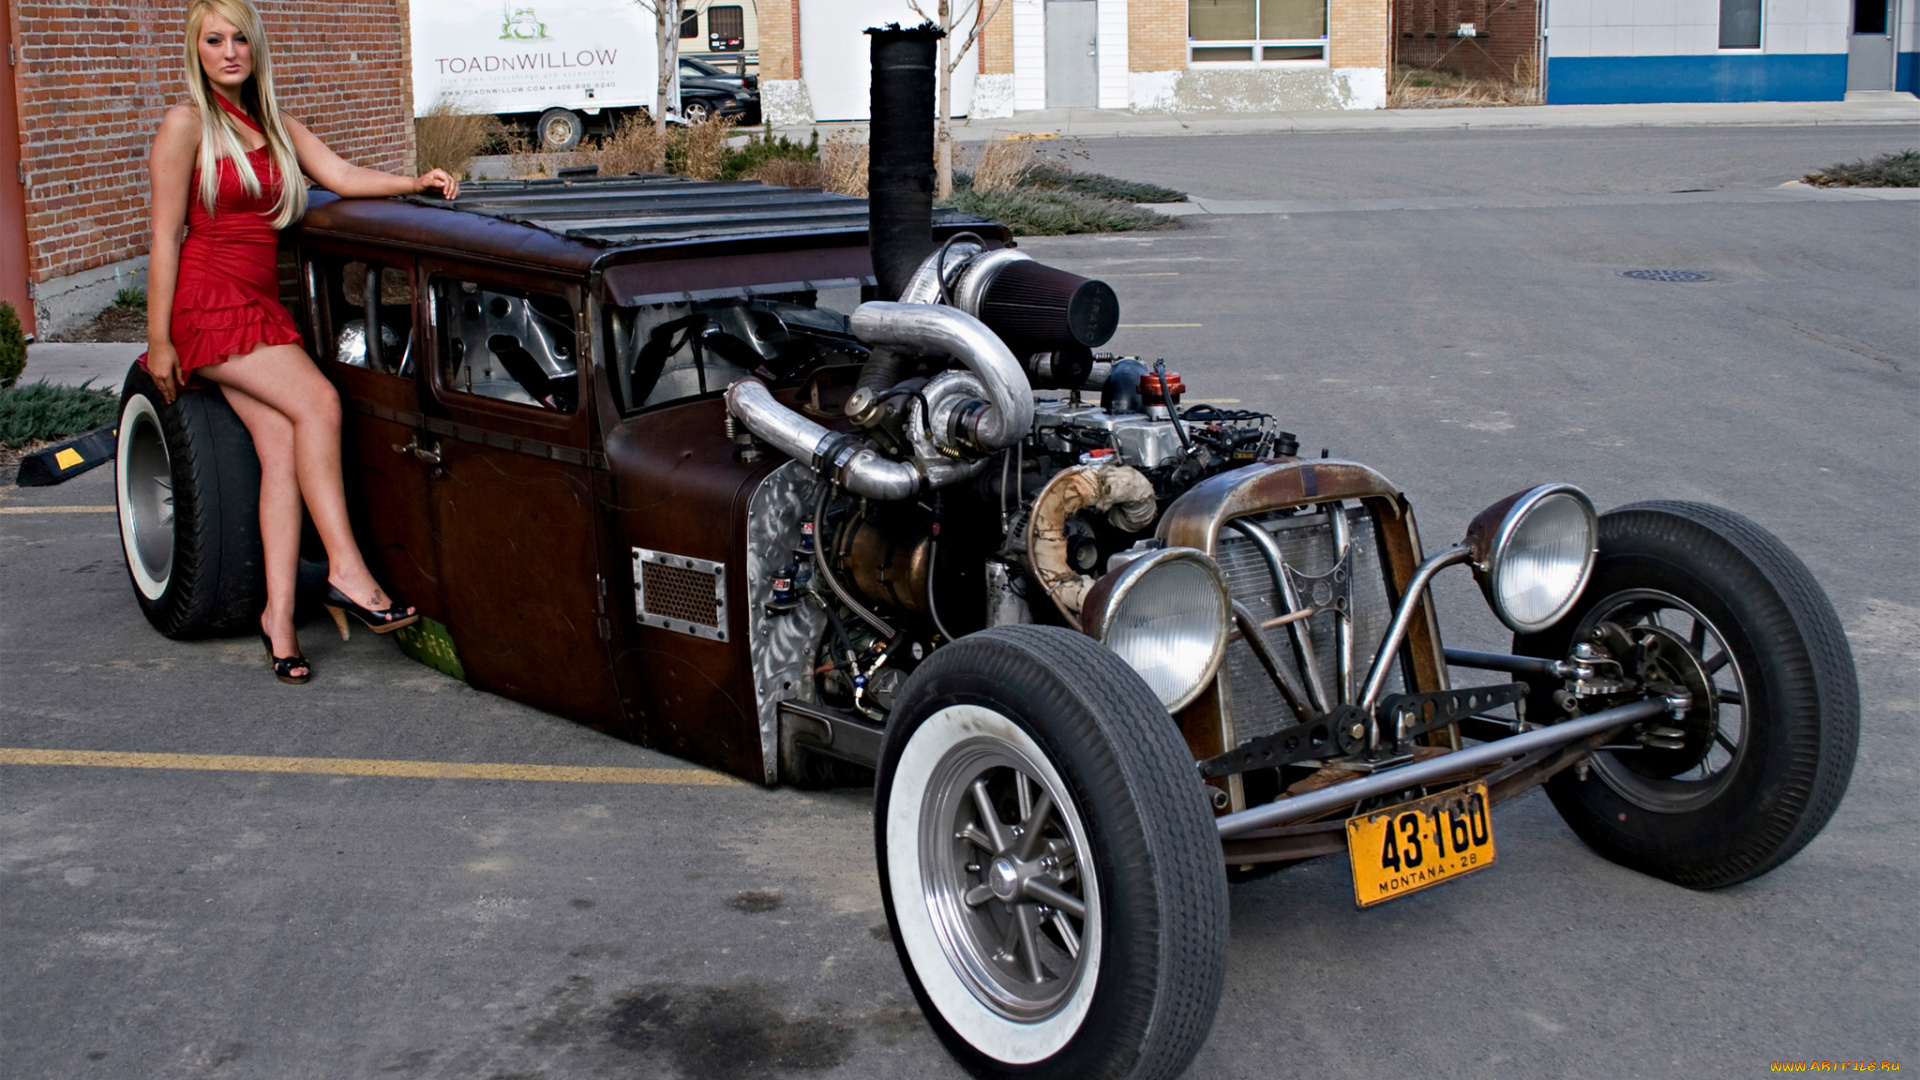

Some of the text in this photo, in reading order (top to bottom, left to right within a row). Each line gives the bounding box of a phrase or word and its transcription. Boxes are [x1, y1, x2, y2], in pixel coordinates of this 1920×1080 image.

[435, 49, 617, 74] TOADNWILLOW
[1379, 852, 1478, 894] MONTANA 28
